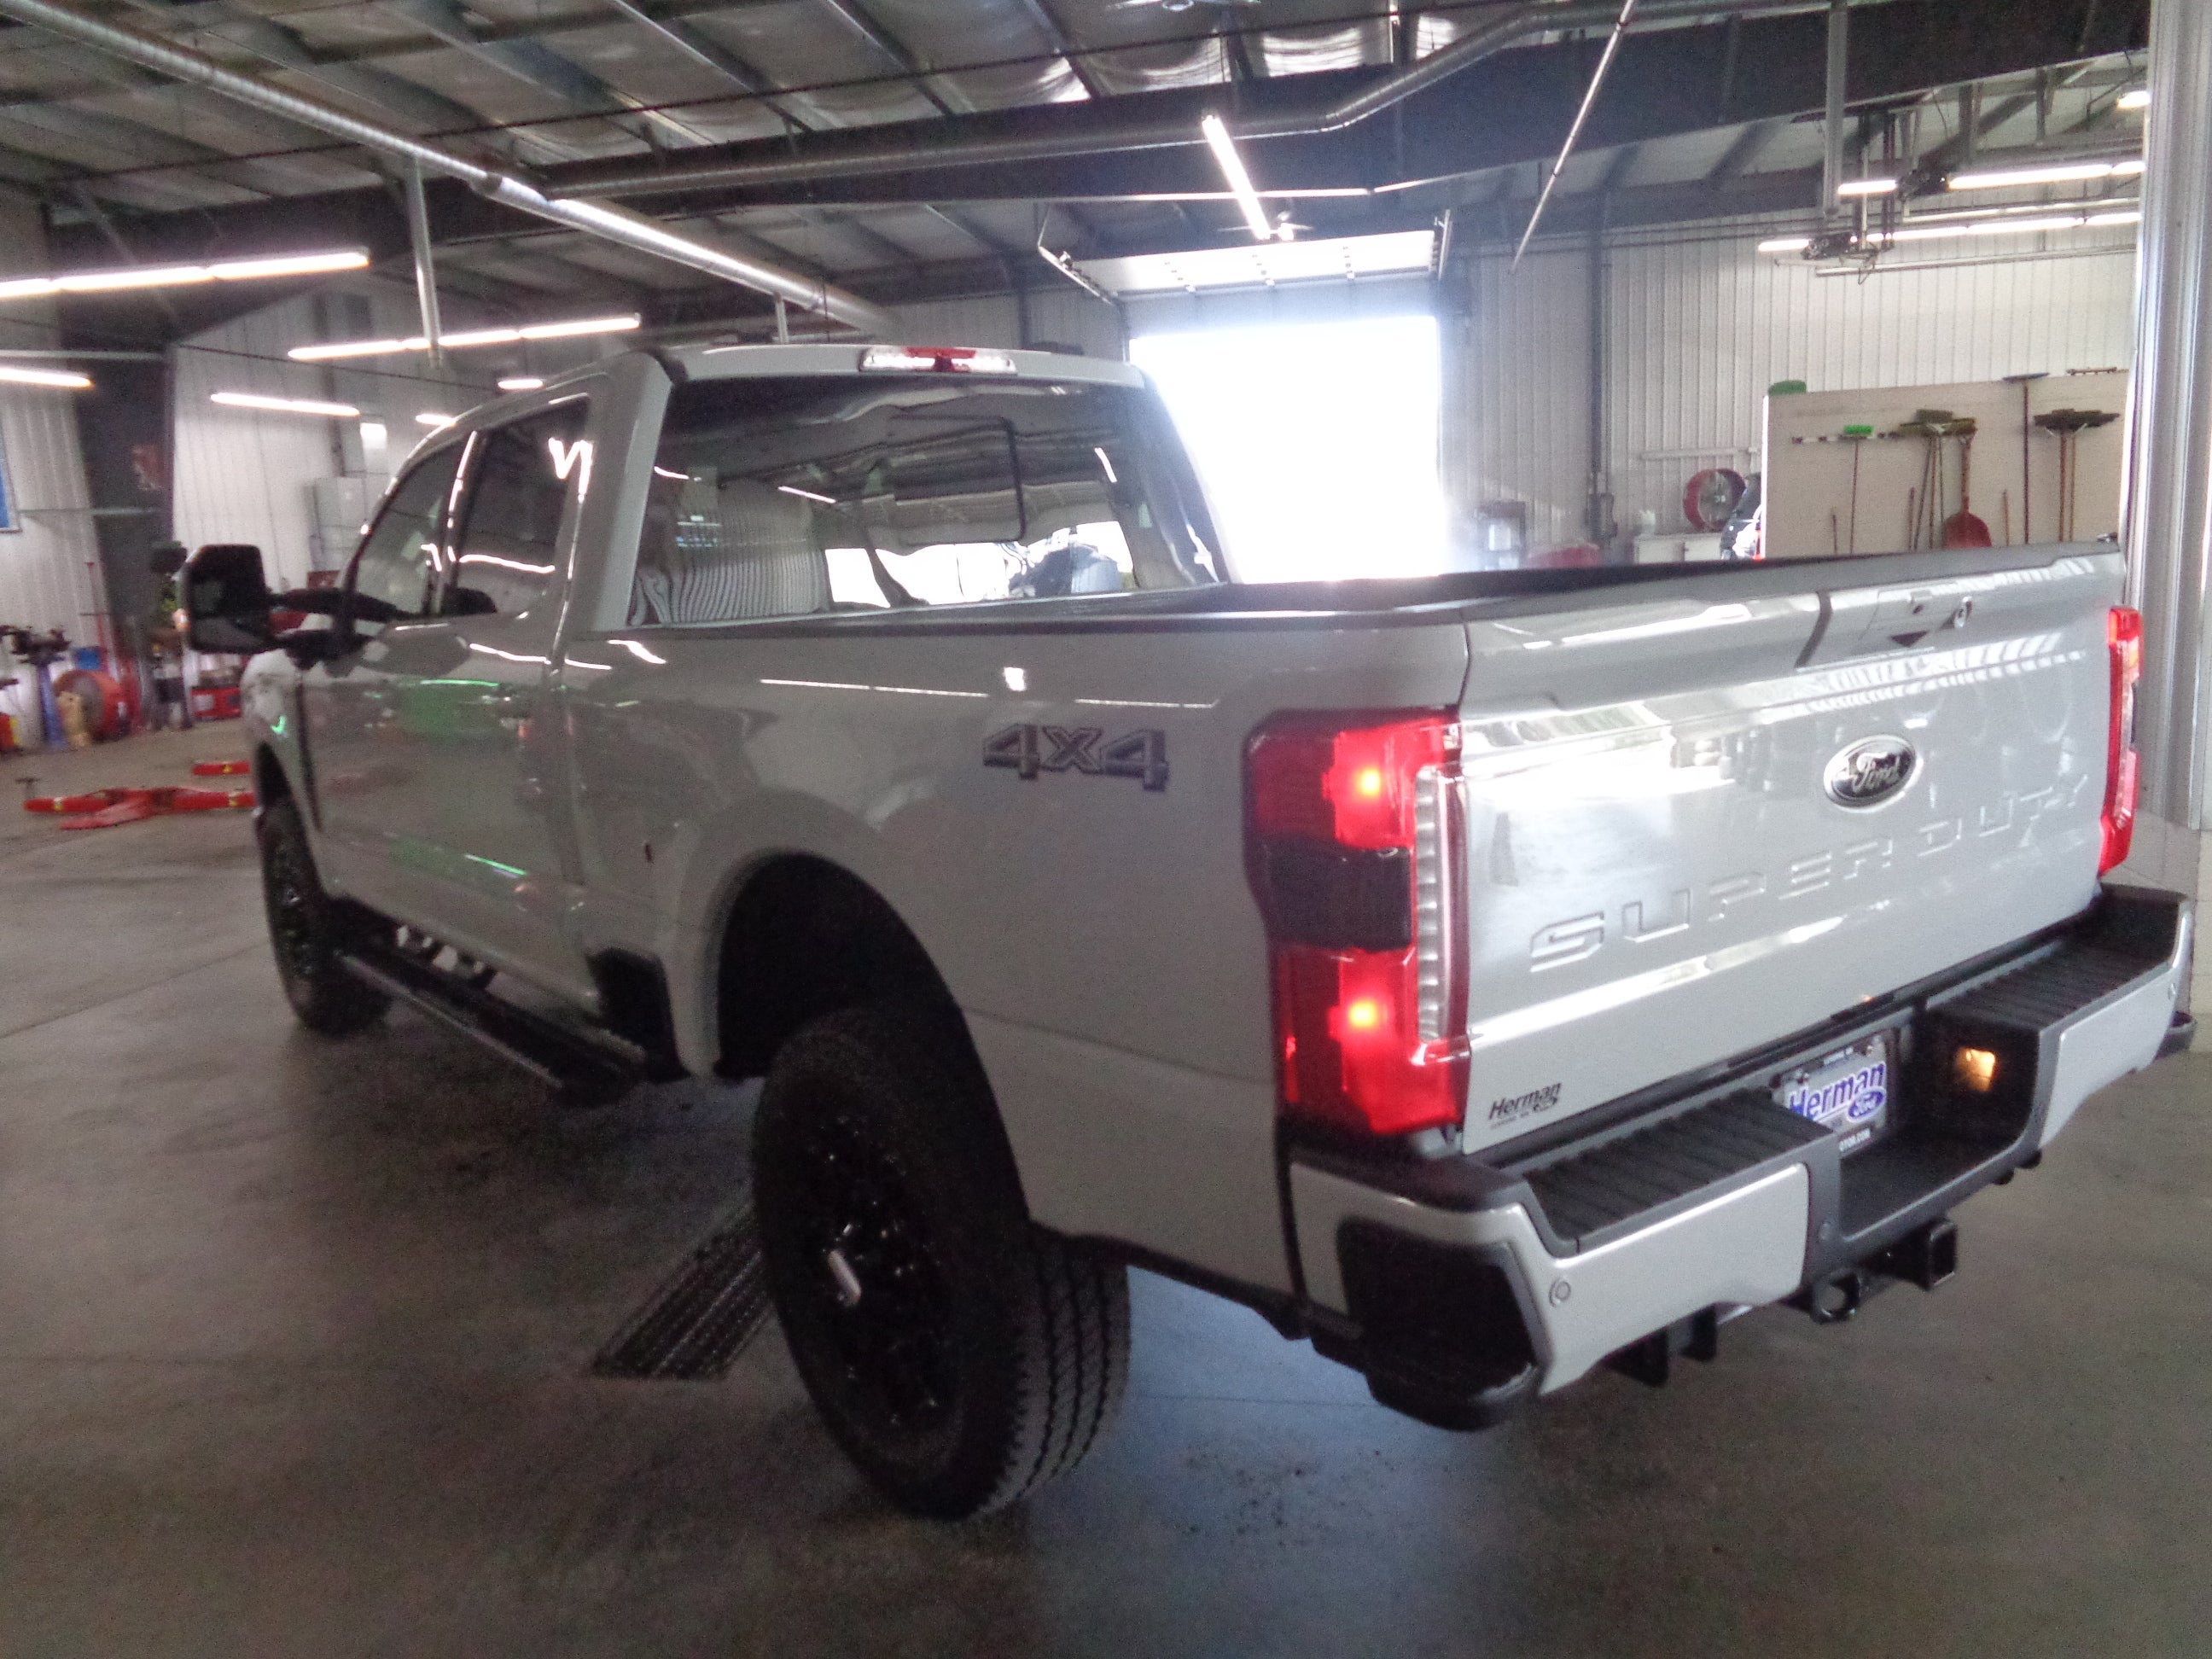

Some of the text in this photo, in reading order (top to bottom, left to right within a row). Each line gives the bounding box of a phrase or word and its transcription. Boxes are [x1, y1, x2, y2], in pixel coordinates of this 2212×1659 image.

[1833, 750, 1901, 794] Ford
[1530, 773, 2089, 974] SUPER DUTY
[1488, 1081, 1562, 1120] Herman
[1789, 1062, 1885, 1121] Herman
